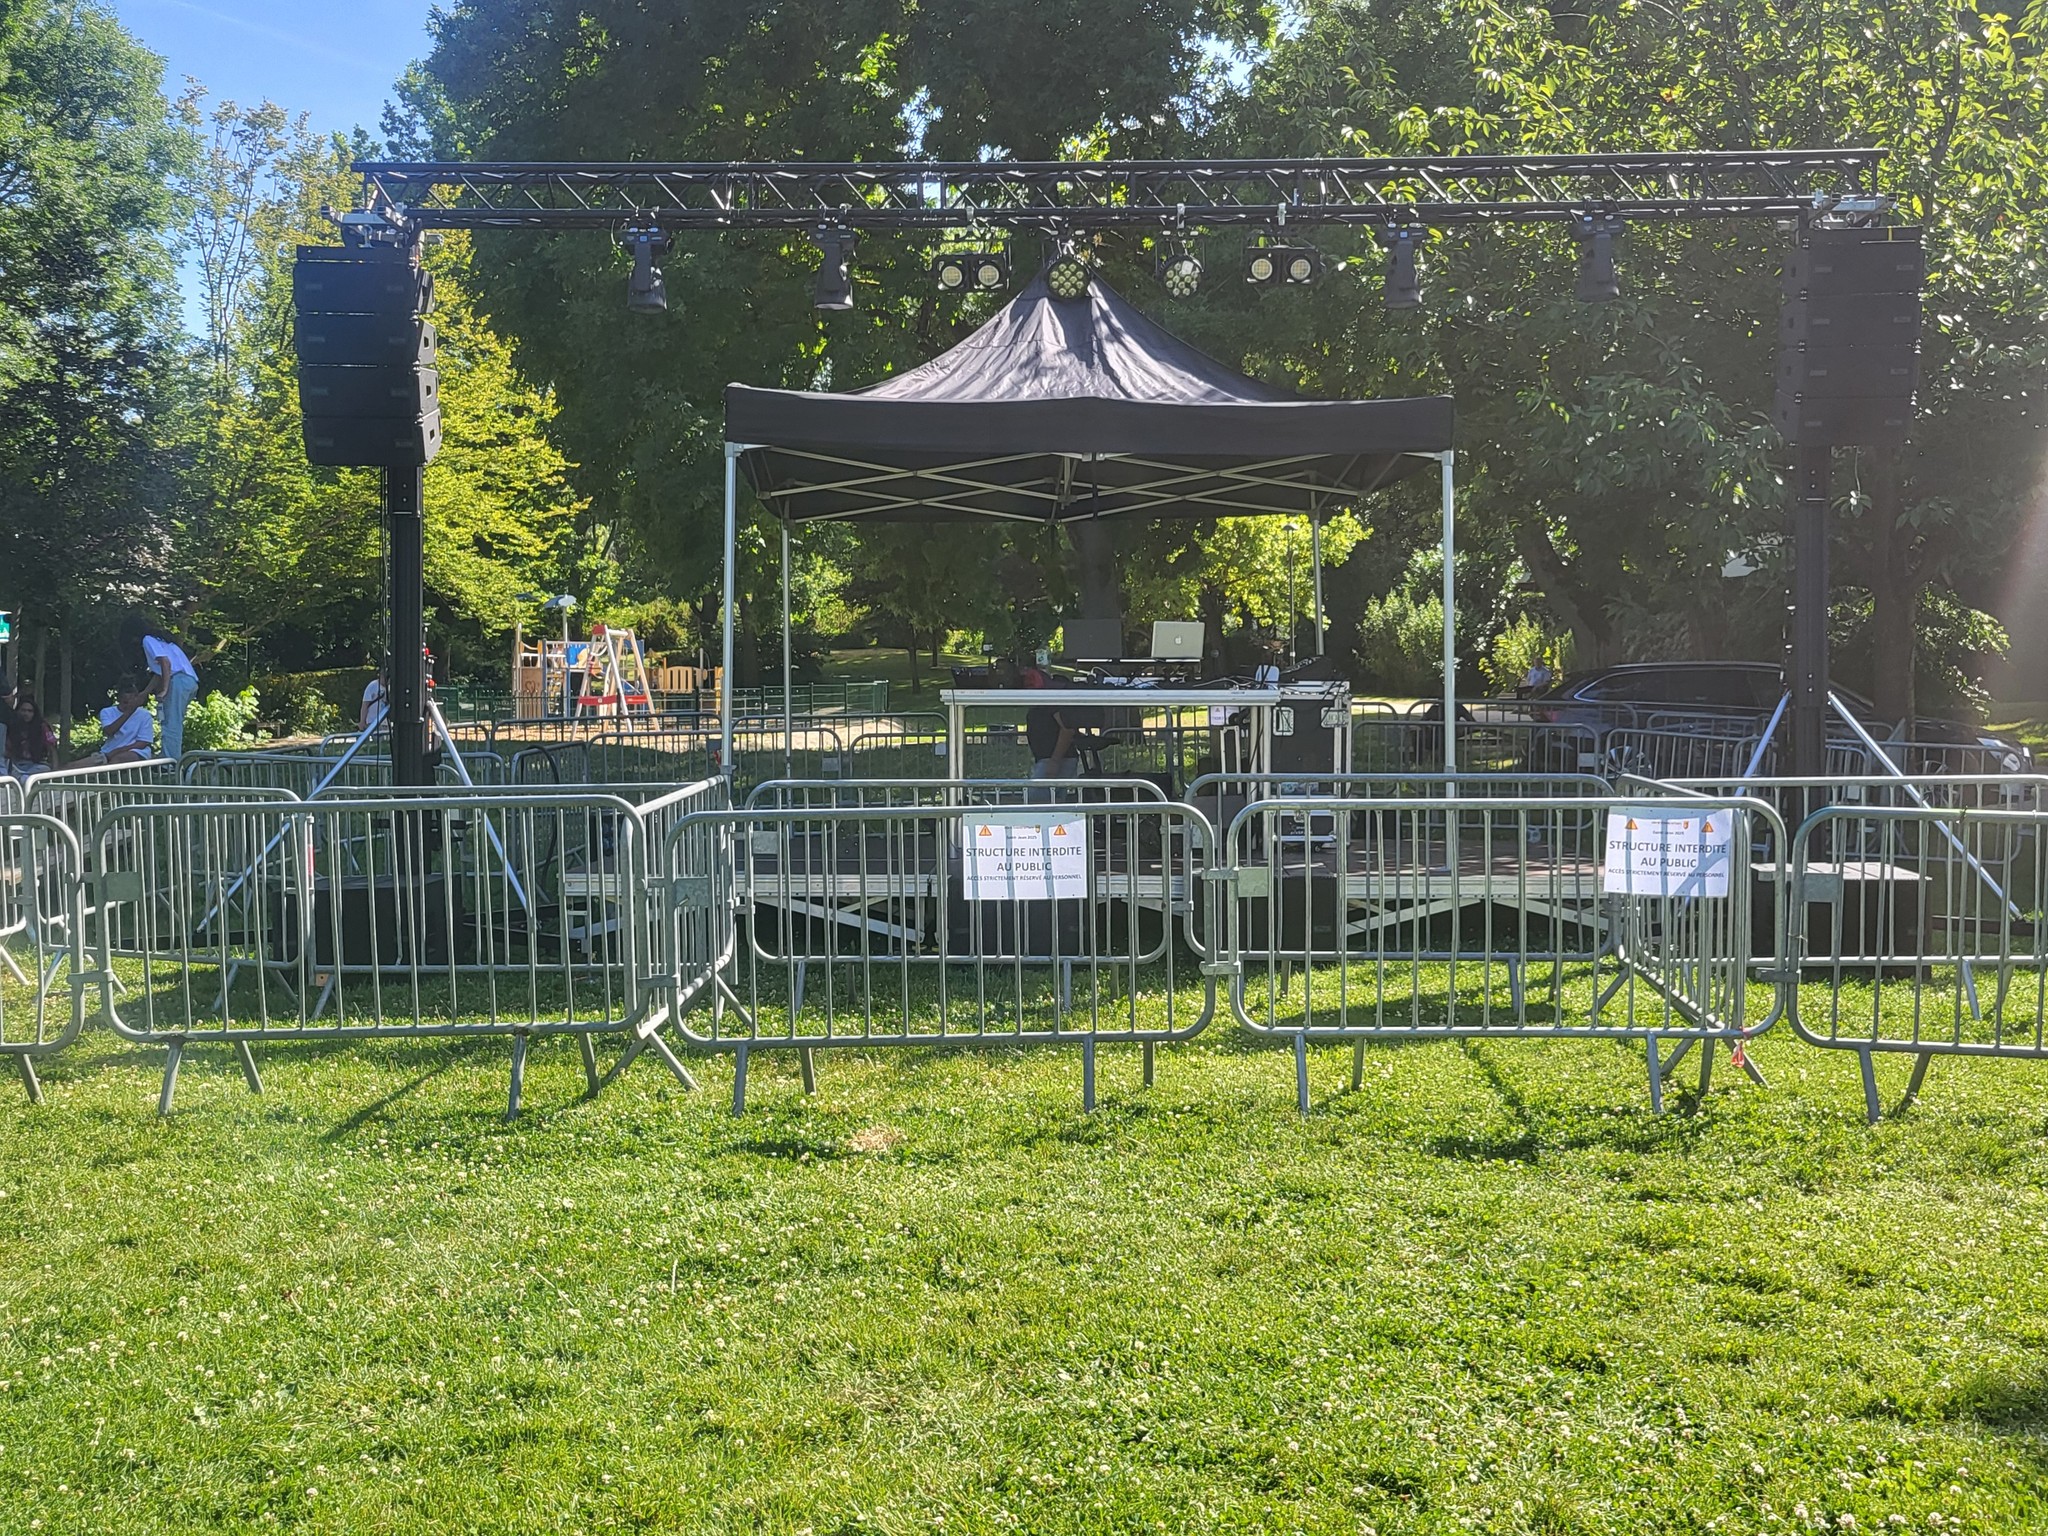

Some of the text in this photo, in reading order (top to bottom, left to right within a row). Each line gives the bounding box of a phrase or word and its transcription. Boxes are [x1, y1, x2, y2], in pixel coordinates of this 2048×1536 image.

[966, 846, 1082, 856] STRUCTURE INTERDITE
[1608, 840, 1726, 854] STRUCTURE INTERDITE
[997, 862, 1052, 872] AU PUBLIC
[1640, 858, 1696, 868] AU PUBLIC
